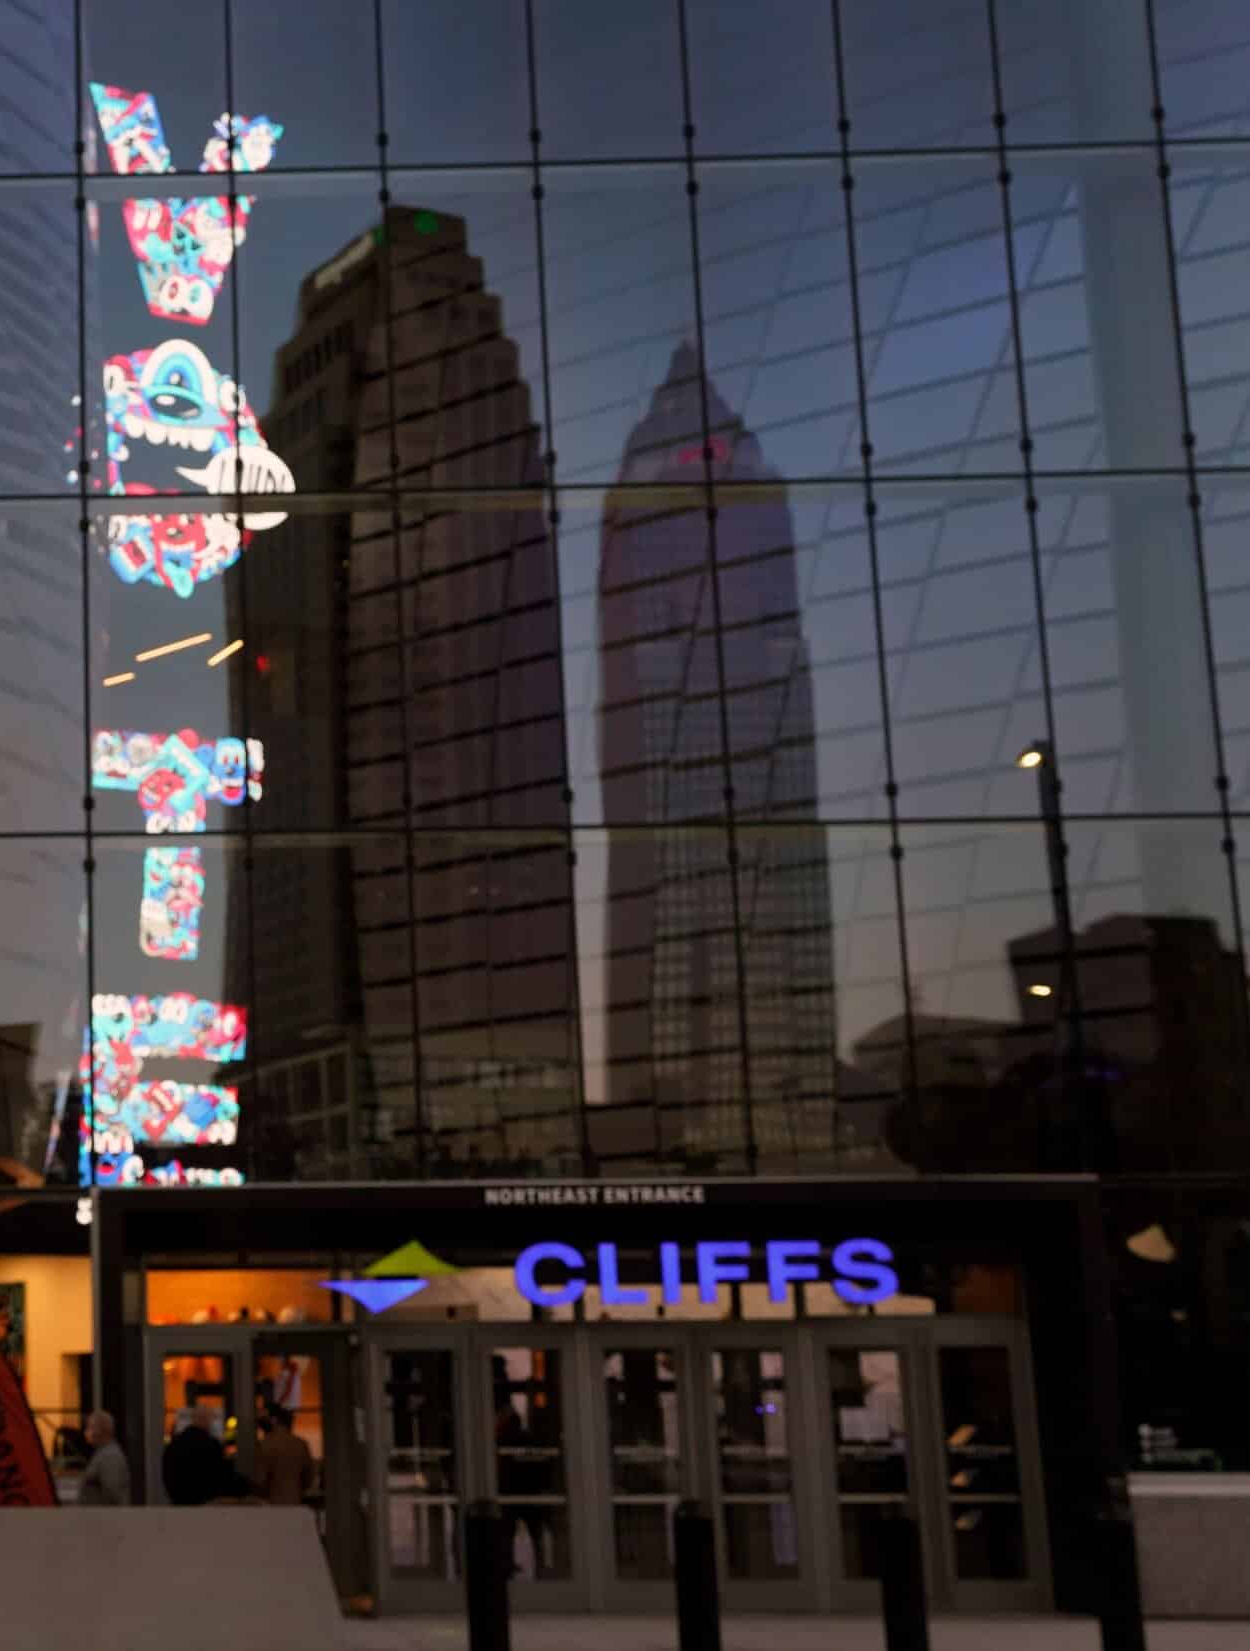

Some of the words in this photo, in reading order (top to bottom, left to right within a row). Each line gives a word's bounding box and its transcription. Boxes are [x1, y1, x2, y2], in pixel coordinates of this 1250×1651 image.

[484, 1186, 598, 1205] NORTHEAST
[603, 1184, 705, 1204] ENTRANCE
[514, 1238, 899, 1307] CLIFFS
